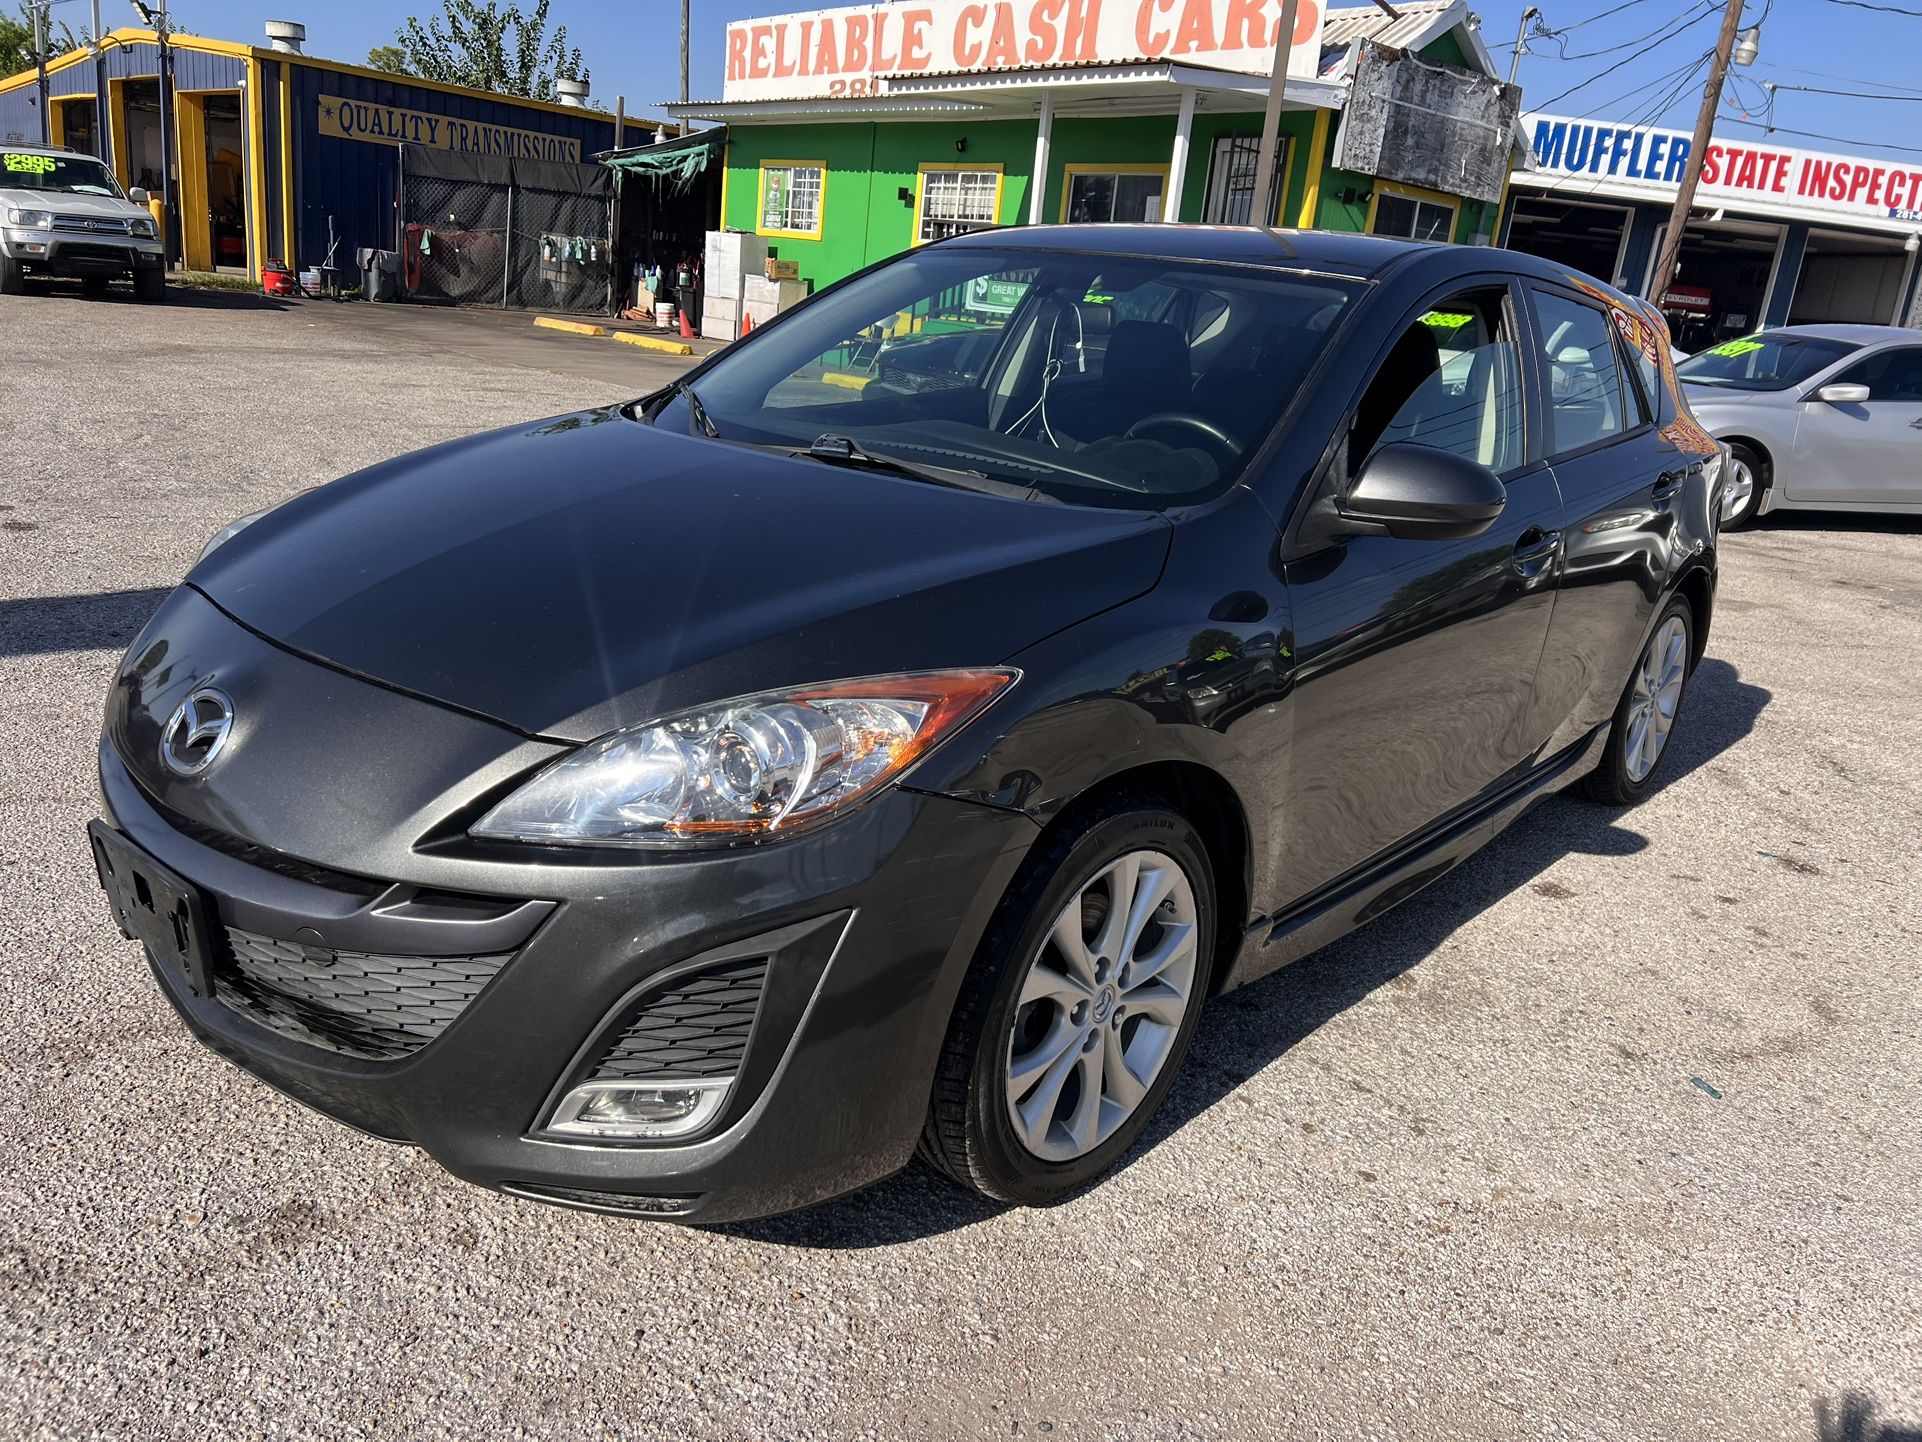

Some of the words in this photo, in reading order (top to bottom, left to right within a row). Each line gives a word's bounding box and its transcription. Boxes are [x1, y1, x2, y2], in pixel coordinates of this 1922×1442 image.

[727, 9, 932, 81] RELIABLE
[953, 0, 1099, 67] CASH
[338, 101, 440, 144] QUALITY
[447, 120, 575, 162] TRANSMISSIONS
[4, 154, 56, 171] $2995
[1534, 121, 1693, 183] MUFFLER
[1702, 145, 1791, 193] STATE
[1798, 158, 1922, 211] INSPECT
[992, 285, 1016, 296] GREAT
